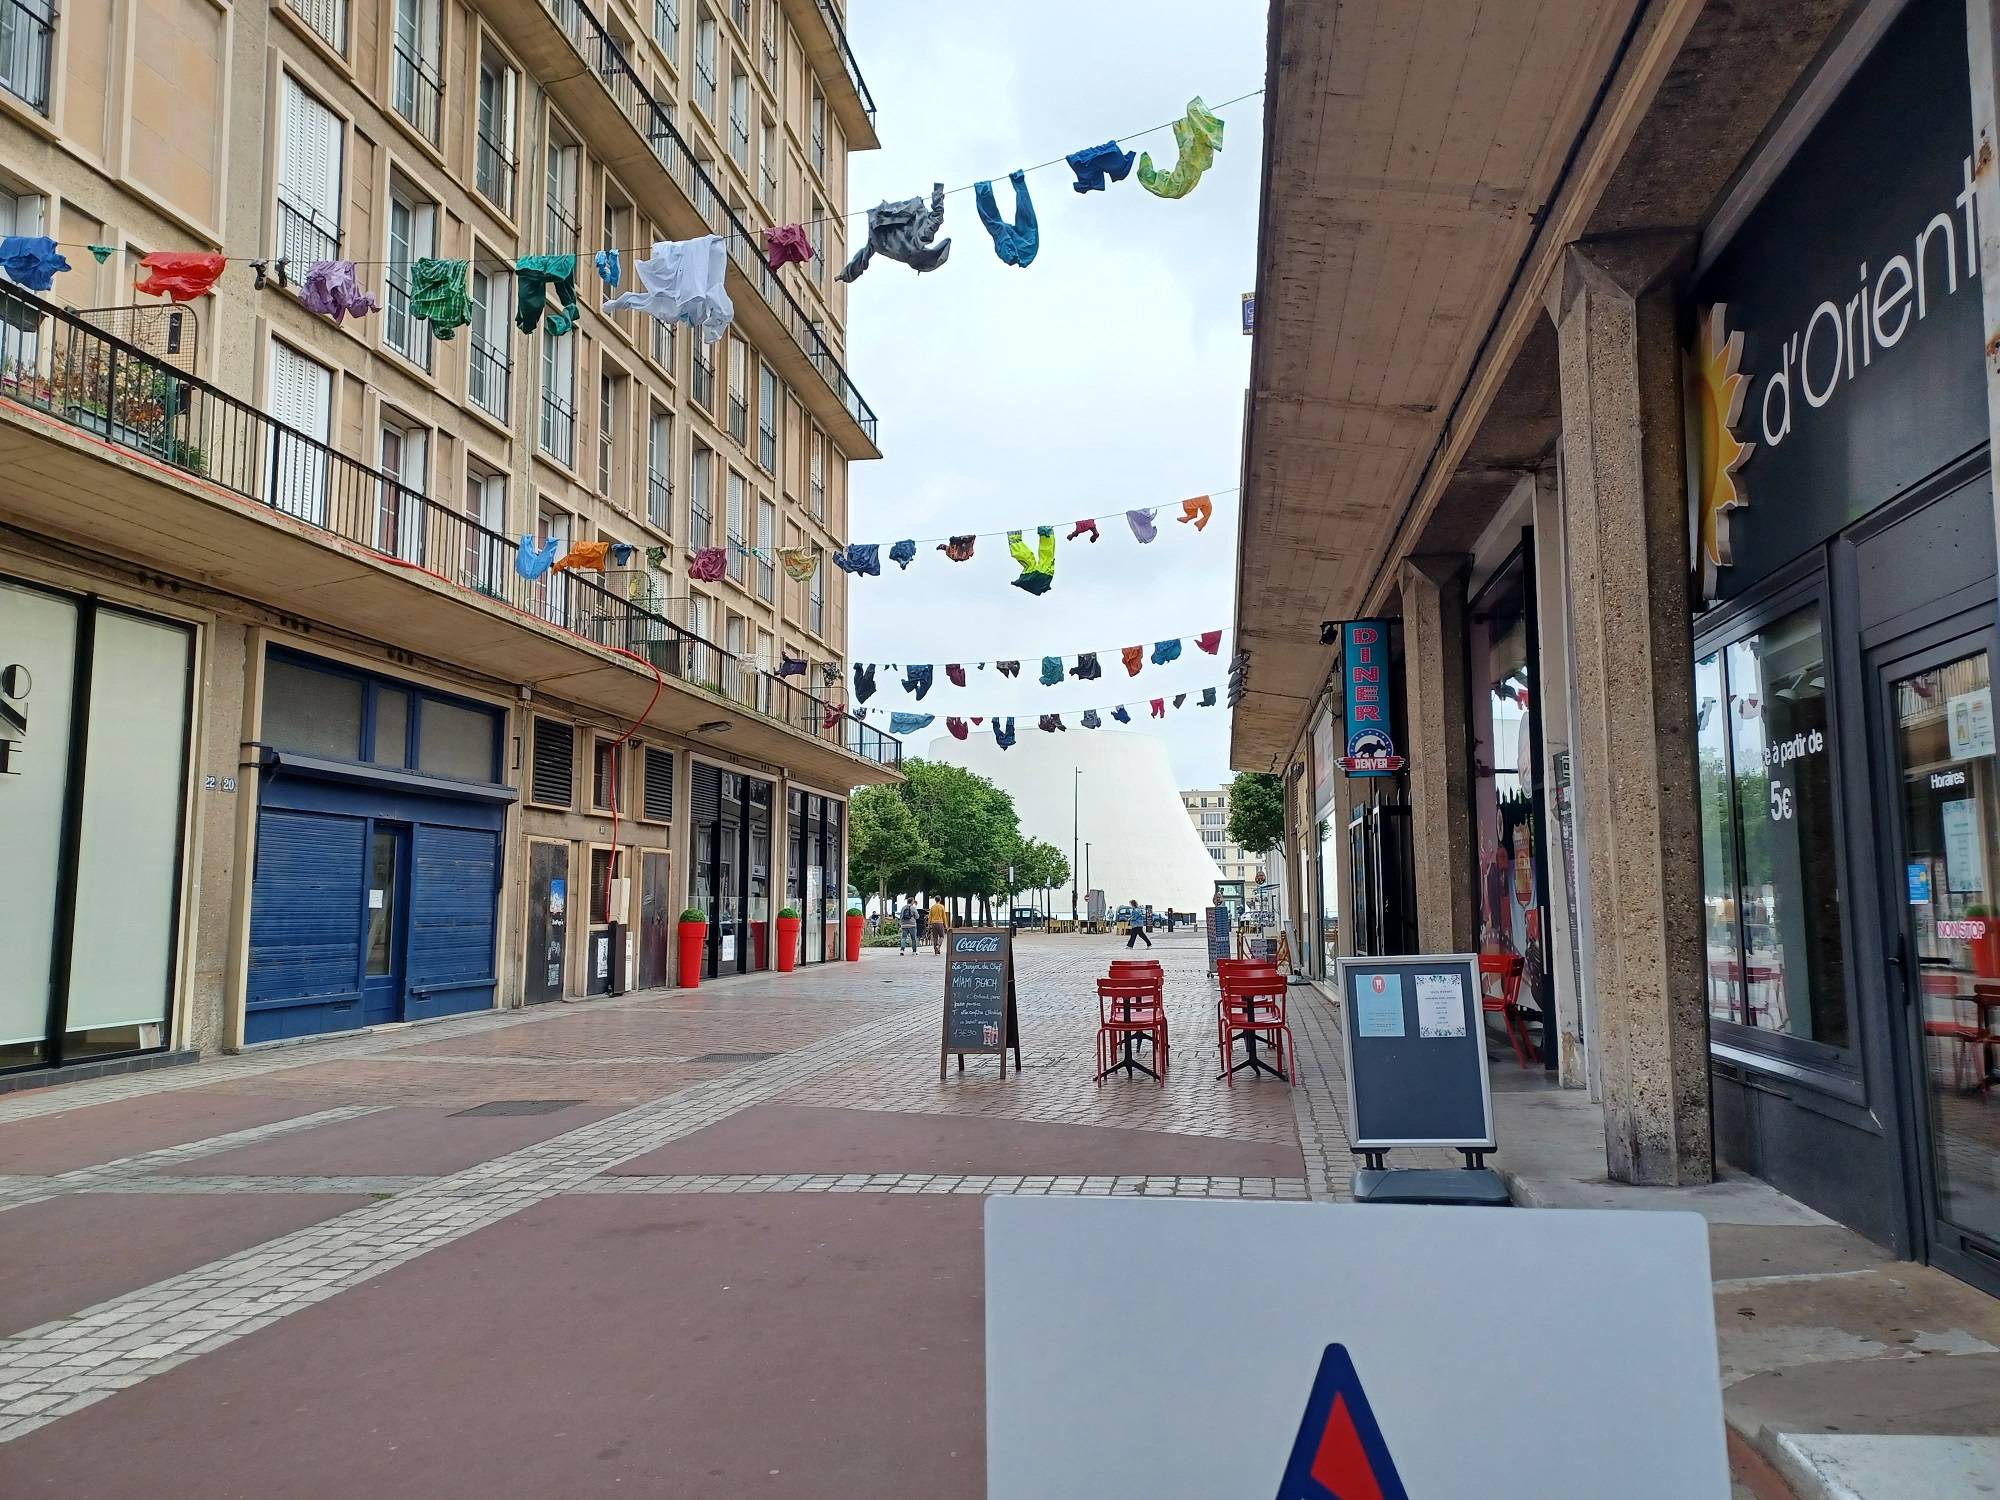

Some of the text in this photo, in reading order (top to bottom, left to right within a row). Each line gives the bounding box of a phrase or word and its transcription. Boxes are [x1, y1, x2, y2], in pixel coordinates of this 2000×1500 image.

[1762, 155, 1977, 447] d'Orient
[1353, 627, 1382, 722] DINER
[1354, 758, 1388, 771] DENVER
[1772, 740, 1780, 764] à
[1781, 732, 1807, 769] partir
[1808, 728, 1823, 754] de
[206, 776, 235, 791] 22 20
[1770, 780, 1793, 821] 5€
[1930, 771, 1966, 790] Horaires
